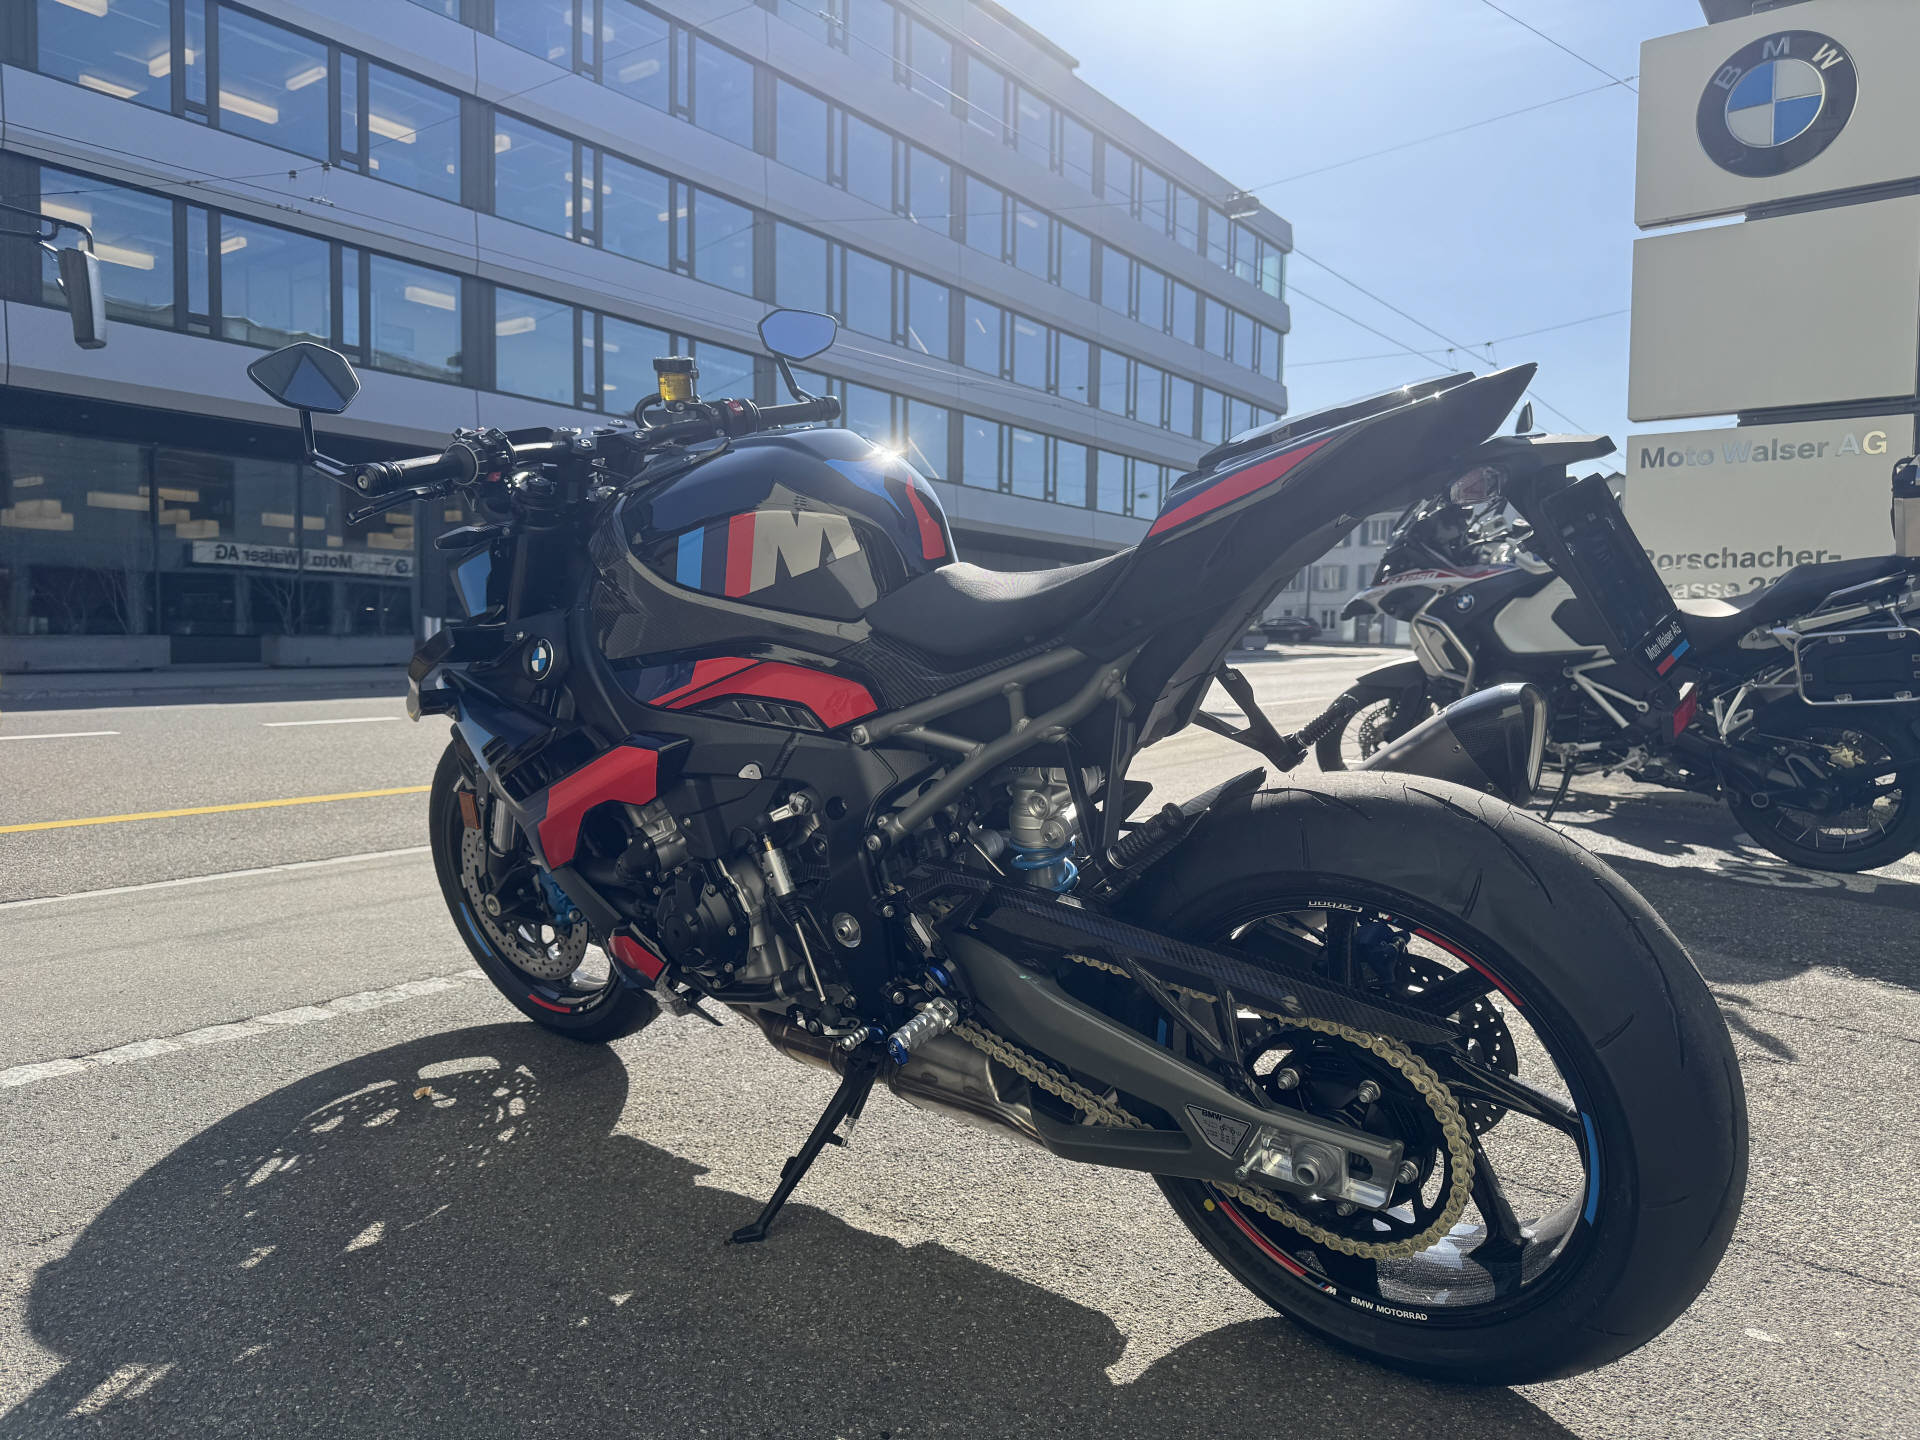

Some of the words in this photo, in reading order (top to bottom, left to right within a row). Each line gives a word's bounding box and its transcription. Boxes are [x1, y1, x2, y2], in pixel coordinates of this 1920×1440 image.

[1714, 36, 1844, 90] BMW
[1640, 446, 1715, 469] Moto
[1721, 437, 1830, 464] Walser
[1836, 430, 1888, 456] AG
[749, 510, 878, 609] M
[1645, 643, 1661, 661] Moto
[1656, 630, 1675, 650] Walser
[1670, 621, 1682, 637] AG
[1350, 1296, 1374, 1310] BMW
[1376, 1304, 1428, 1321] MOTORRAD
